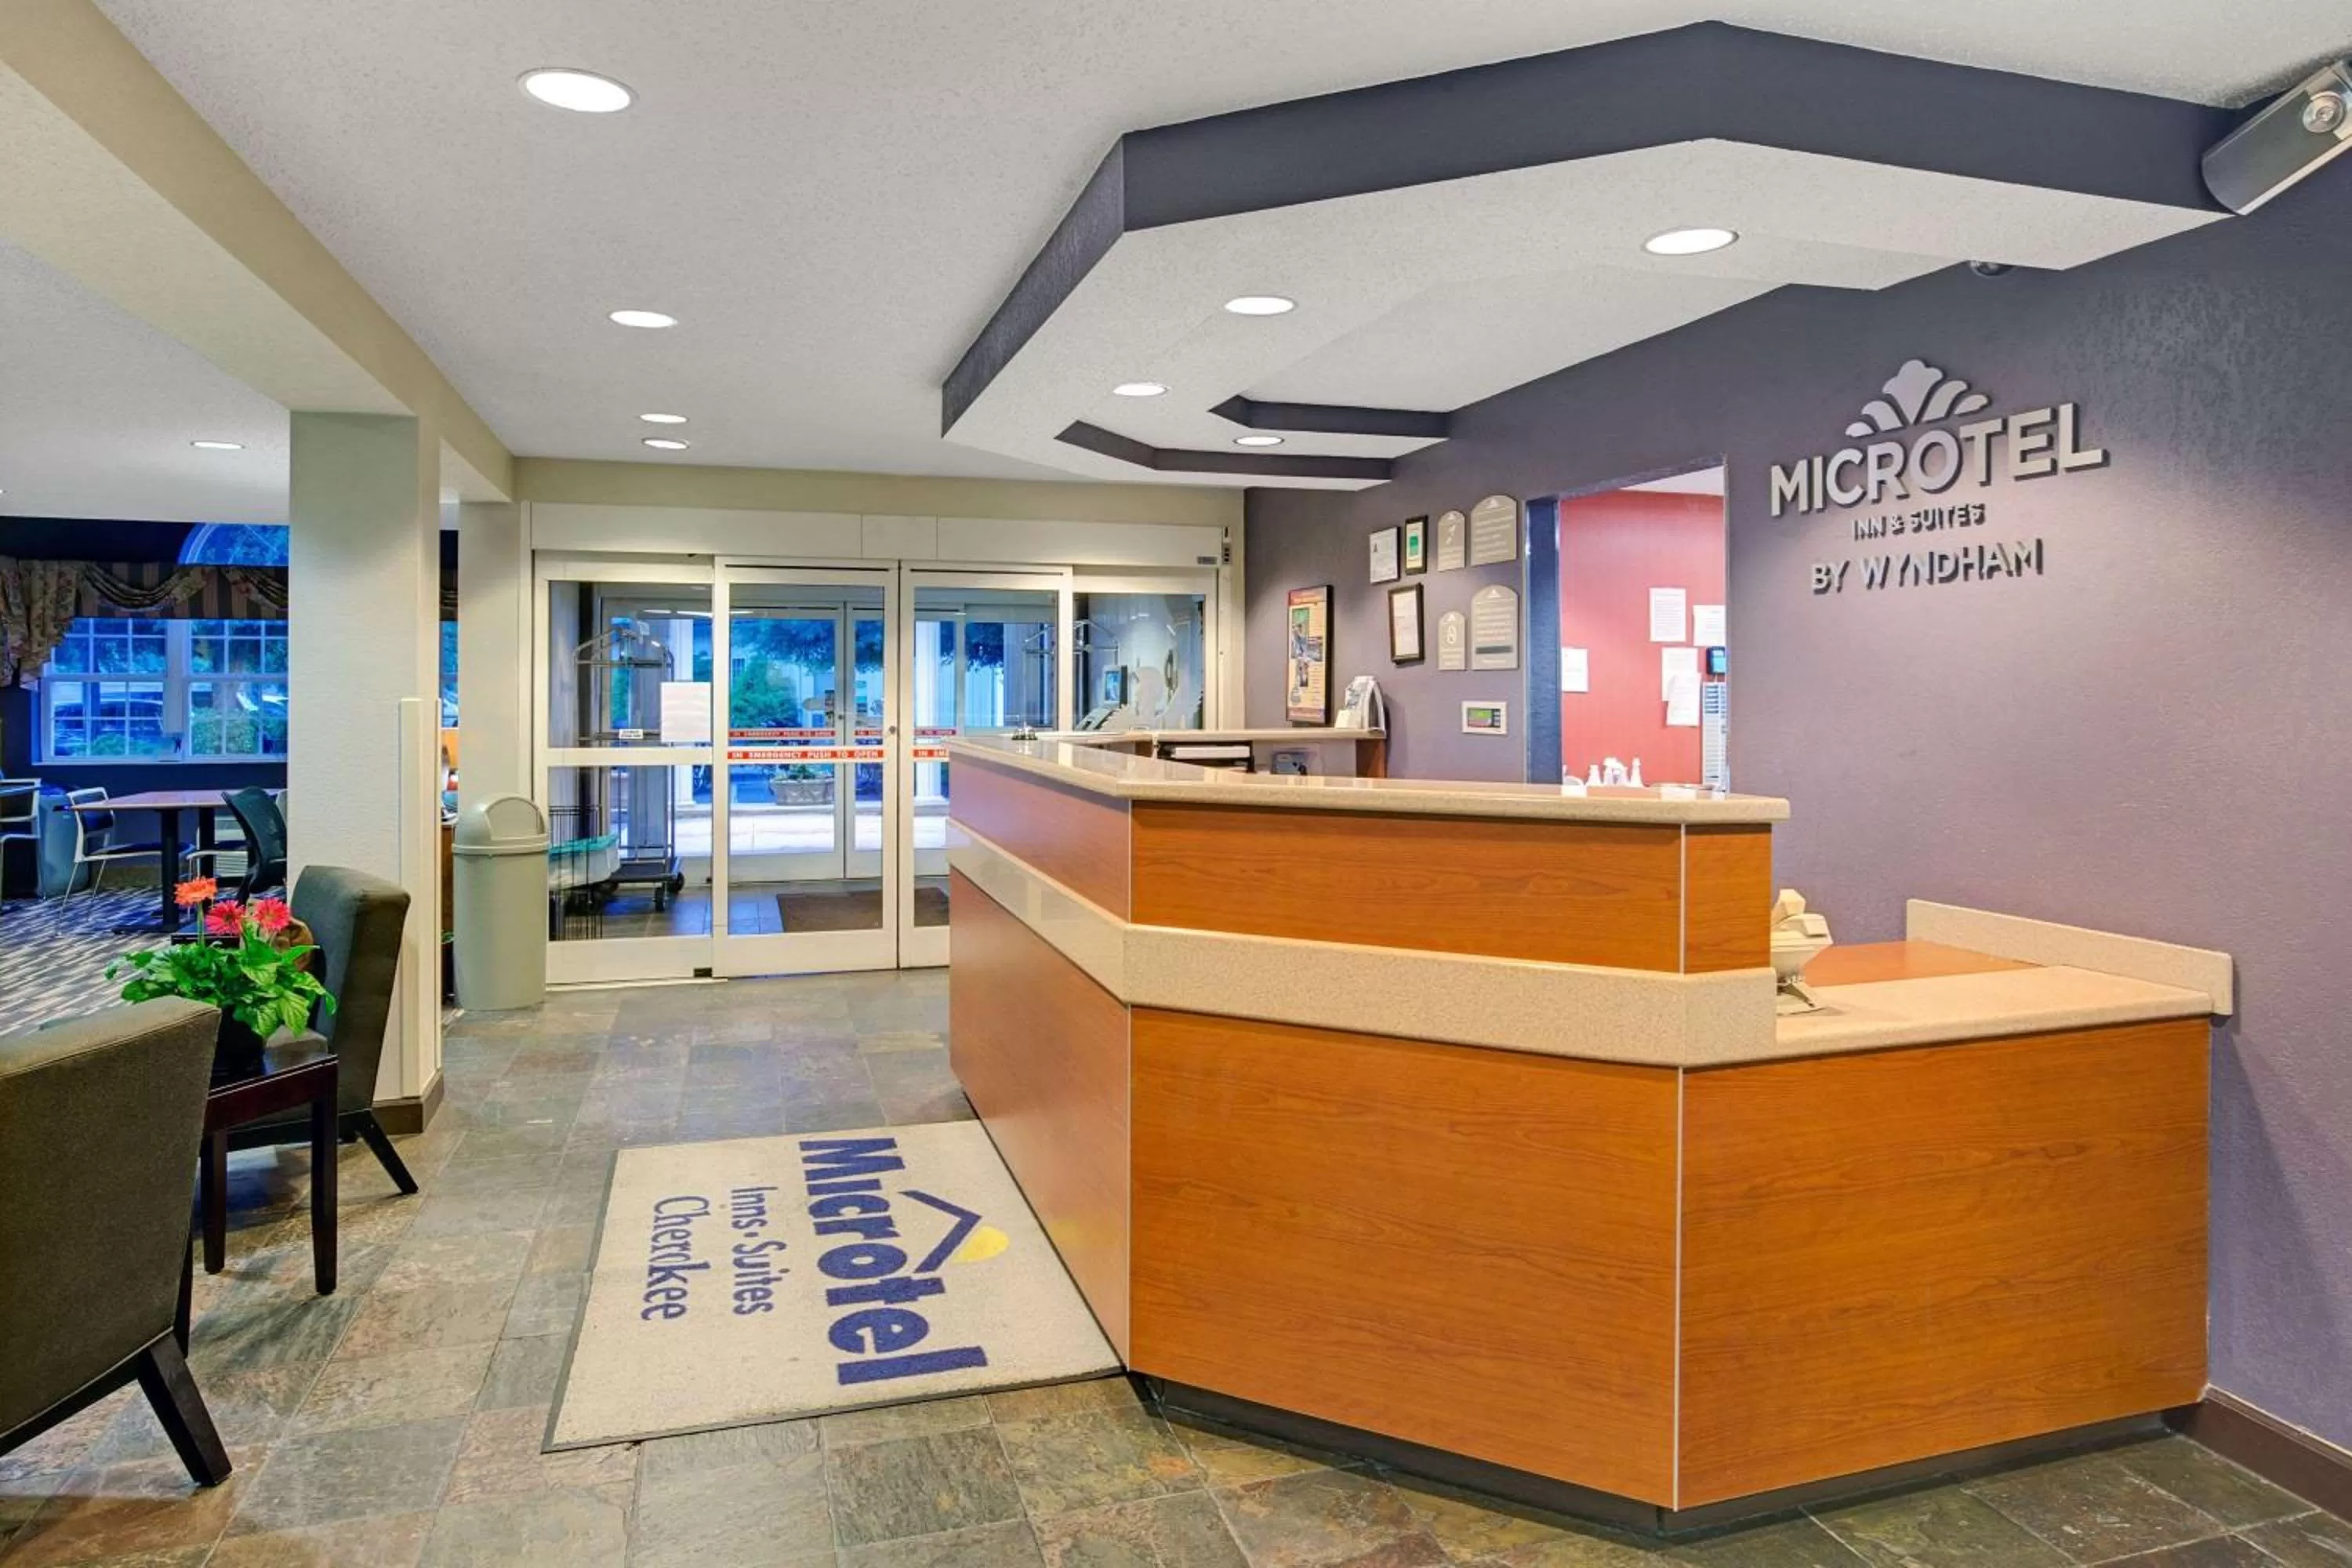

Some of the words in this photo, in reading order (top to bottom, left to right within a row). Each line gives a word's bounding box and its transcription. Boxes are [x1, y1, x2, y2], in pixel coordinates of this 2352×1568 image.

[1770, 402, 2107, 517] MICROTEL
[1811, 559, 1852, 594] BY
[1860, 538, 2044, 590] WYNDHAM
[1853, 517, 1886, 540] INN
[1891, 515, 1905, 535] &
[1910, 503, 1987, 534] SUITES
[640, 1196, 711, 1321] Cherokee
[799, 1138, 988, 1385] Microtel
